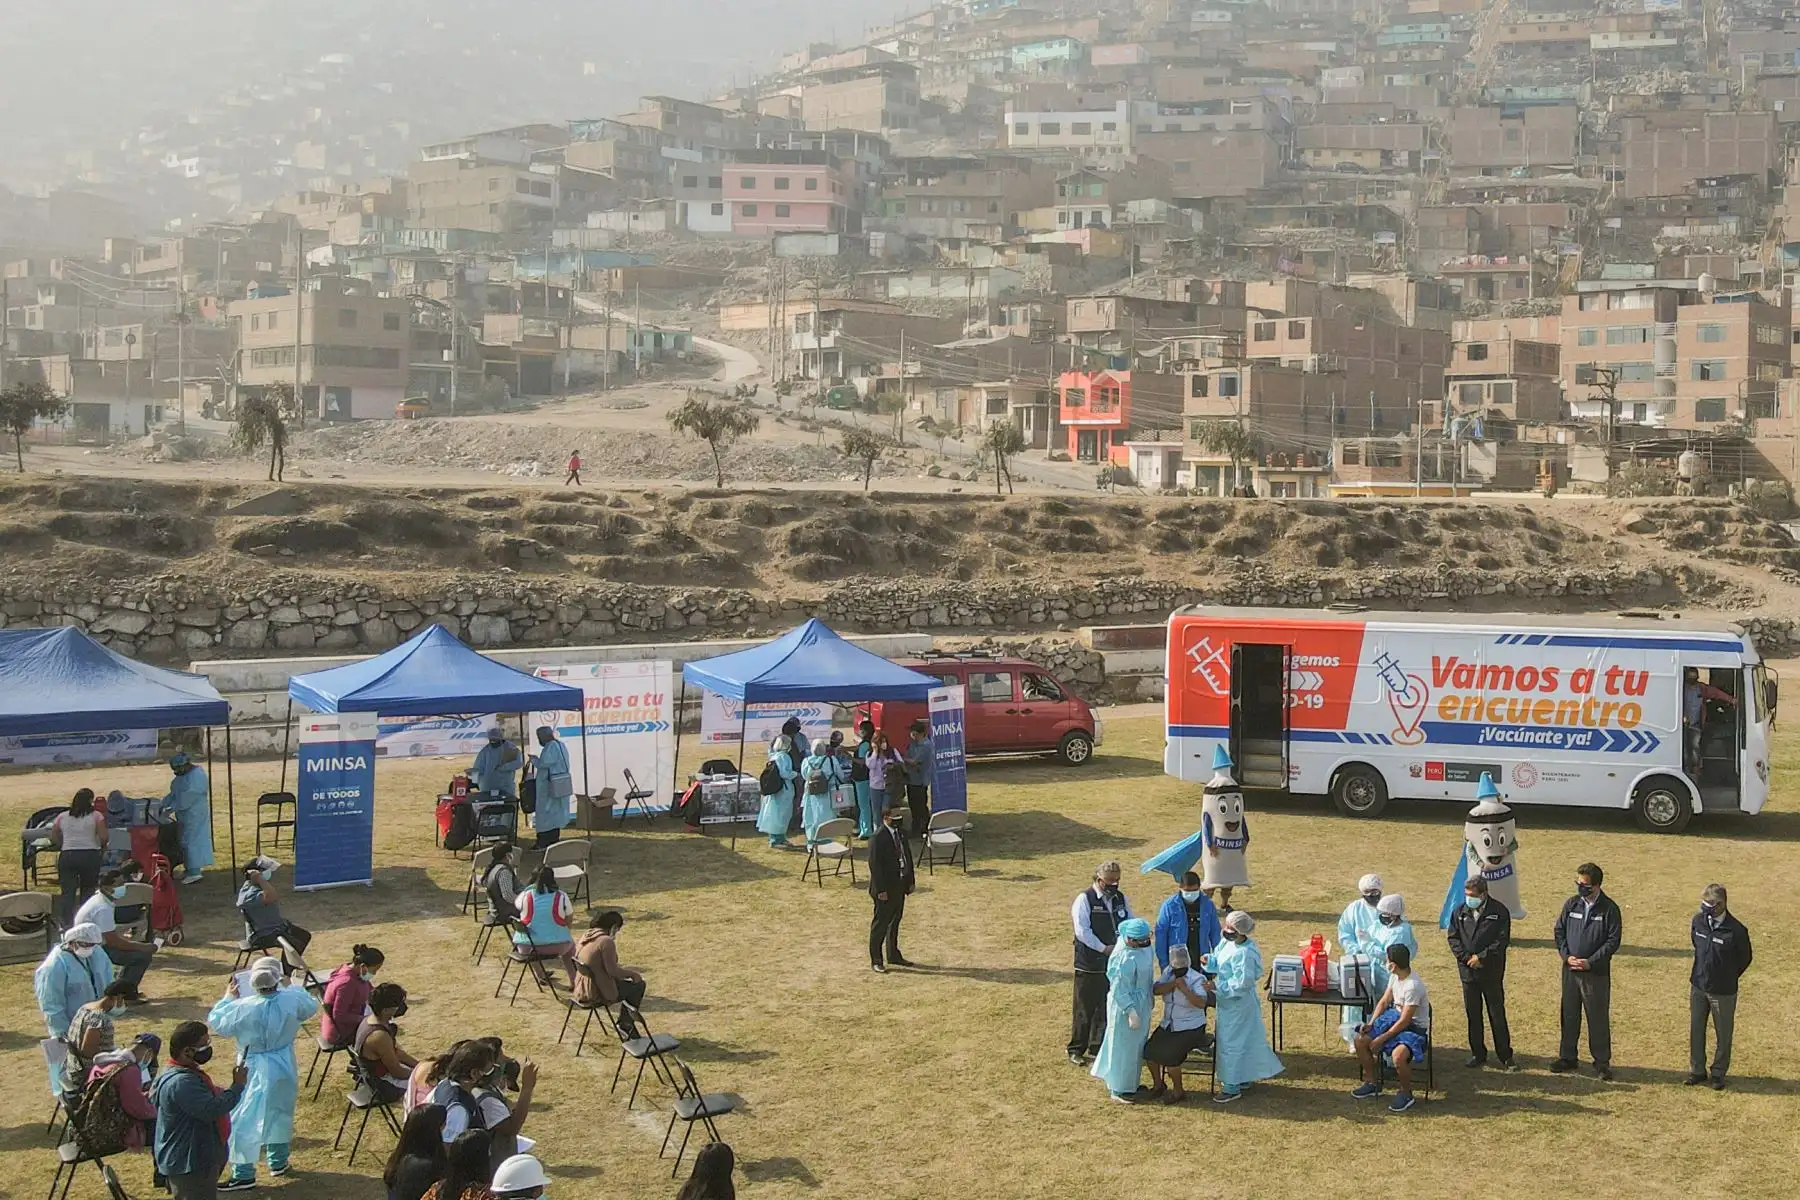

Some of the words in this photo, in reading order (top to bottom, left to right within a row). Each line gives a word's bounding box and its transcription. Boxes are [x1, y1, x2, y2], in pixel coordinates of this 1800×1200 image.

[1432, 656, 1560, 693] Vamos
[1570, 668, 1595, 694] a
[1605, 665, 1649, 696] tu
[584, 695, 623, 709] mos
[627, 694, 639, 707] a
[643, 691, 664, 707] tu
[1438, 695, 1642, 729] encuentro
[932, 722, 963, 737] MINSA
[1478, 727, 1564, 744] ¡Vacúnate
[1564, 731, 1593, 749] ya!
[306, 756, 367, 773] MINSA
[312, 792, 326, 800] DE
[327, 790, 361, 799] TODOS
[1481, 867, 1511, 879] MINSA
